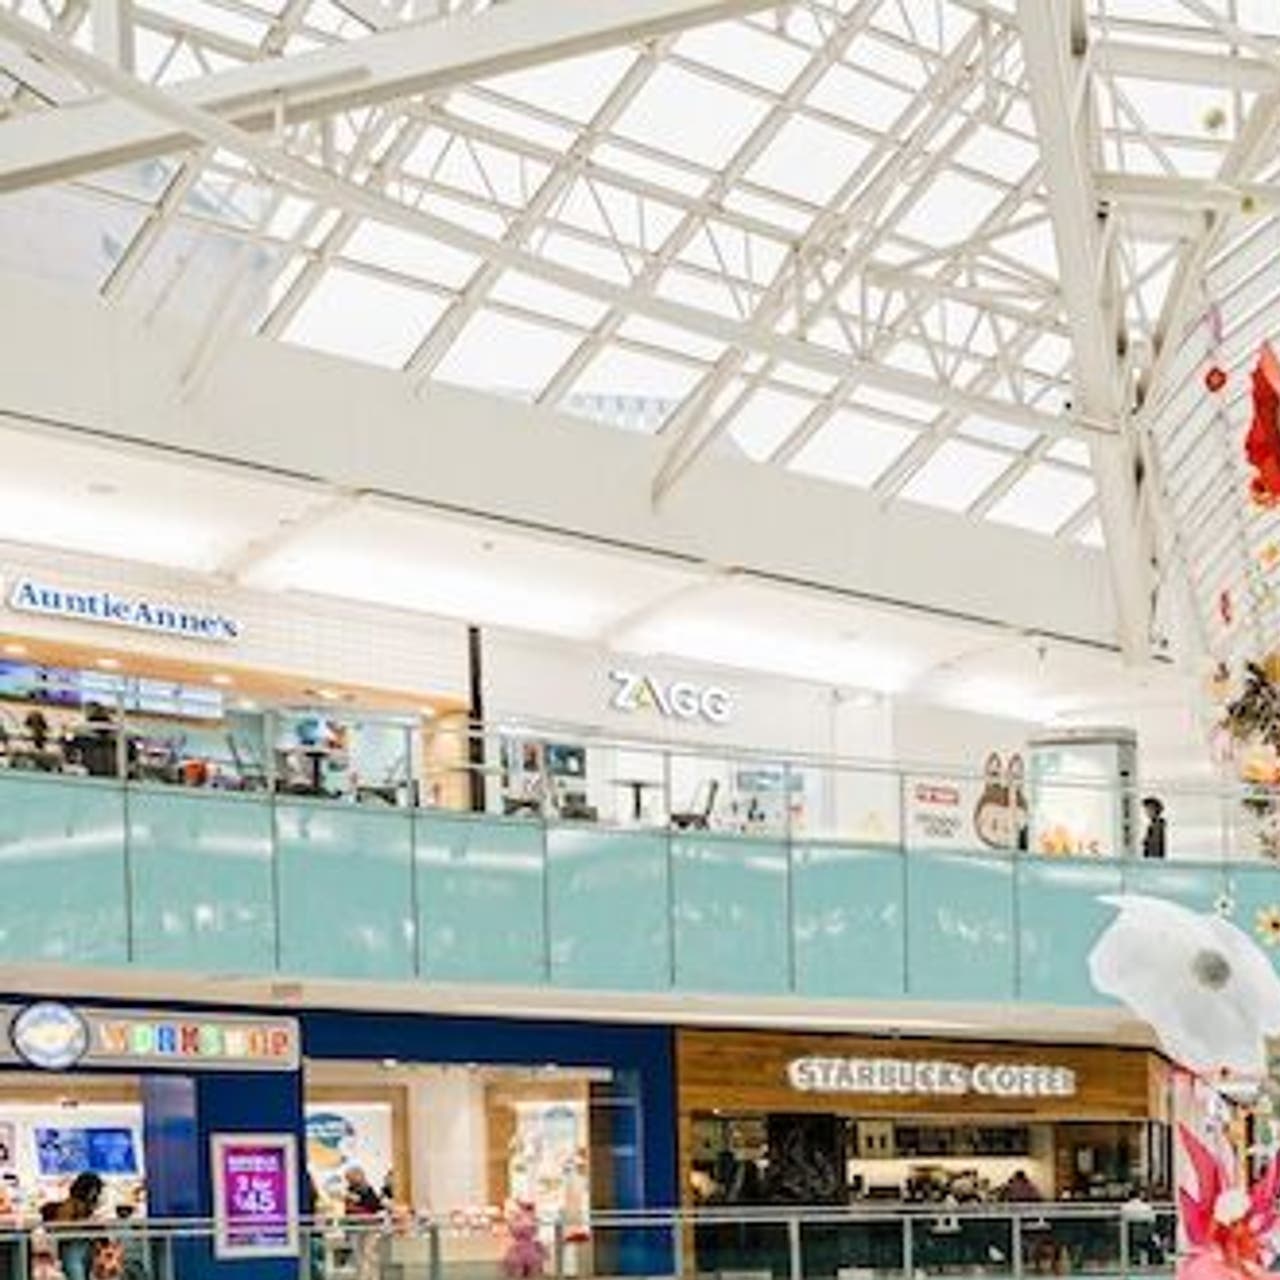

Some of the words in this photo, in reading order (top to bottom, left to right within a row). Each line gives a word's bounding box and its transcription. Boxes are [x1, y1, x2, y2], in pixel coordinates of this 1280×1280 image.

[18, 583, 131, 619] Auntie
[134, 602, 238, 637] Anne's
[608, 669, 735, 722] ZAGG
[791, 1057, 969, 1094] STARBUCKS
[973, 1062, 1076, 1096] COFFEE
